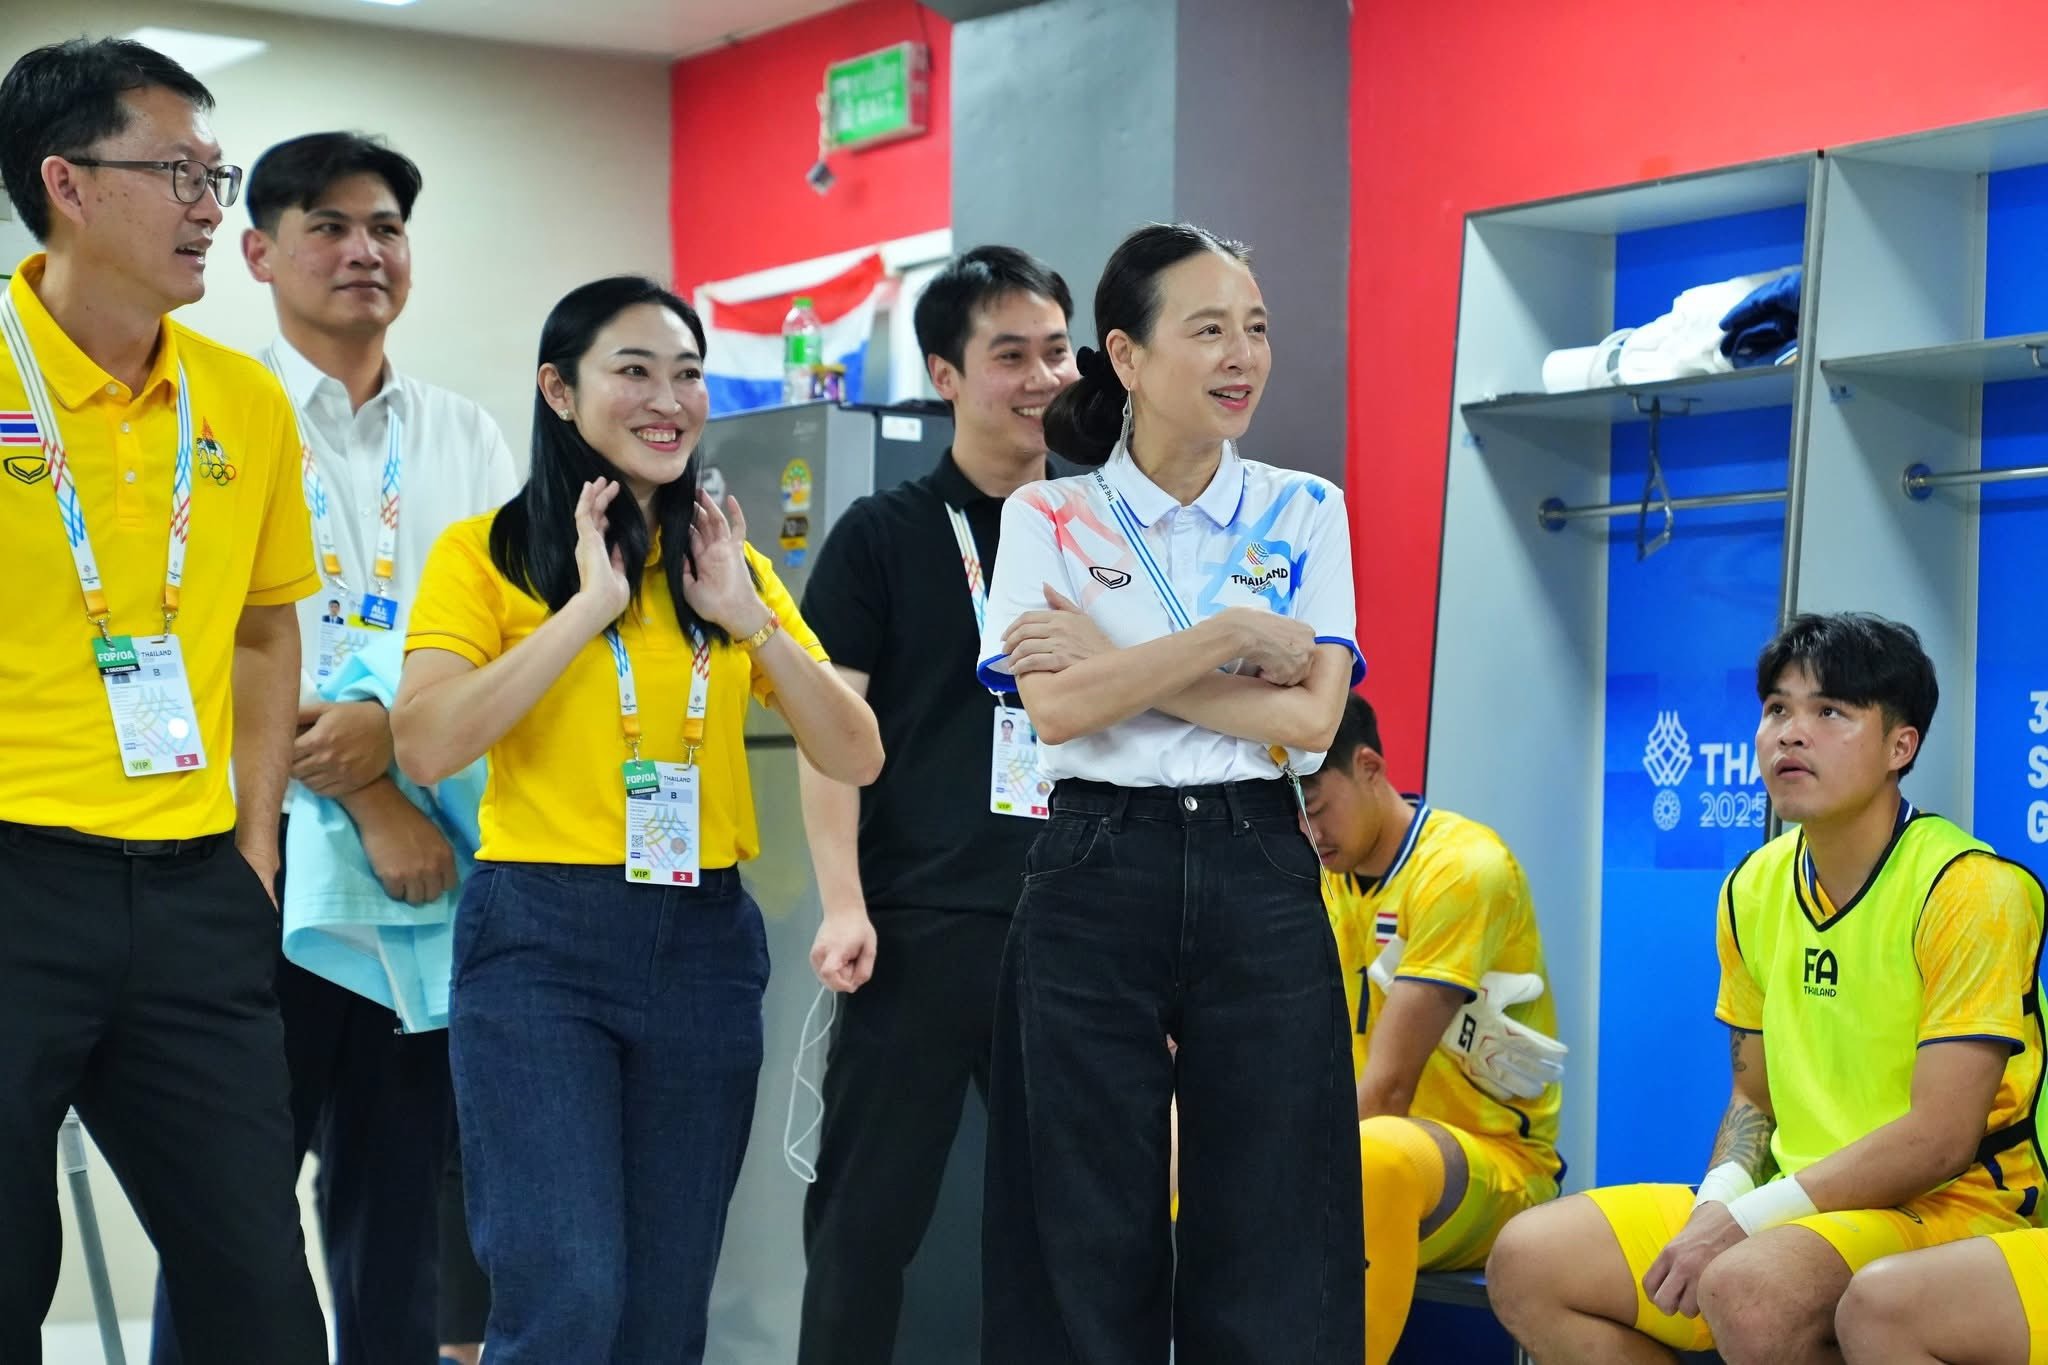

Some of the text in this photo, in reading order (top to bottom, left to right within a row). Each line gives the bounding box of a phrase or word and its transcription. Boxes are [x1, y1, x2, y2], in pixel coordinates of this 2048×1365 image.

[1231, 567, 1288, 587] THAILAND
[97, 650, 135, 663] FOP/OA
[141, 649, 172, 658] THAILAND
[153, 668, 161, 676] B
[132, 761, 149, 770] VIP
[183, 756, 191, 764] 3
[2027, 745, 2048, 789] S
[625, 772, 657, 785] FOP/OA
[663, 775, 692, 783] THAILAND
[670, 791, 677, 799] B
[1699, 791, 1767, 828] 2025
[2027, 801, 2048, 843] G
[633, 870, 649, 879] VIP
[1803, 947, 1839, 986] FA
[1803, 986, 1837, 998] THAILAND
[1356, 965, 1370, 1035] 1
